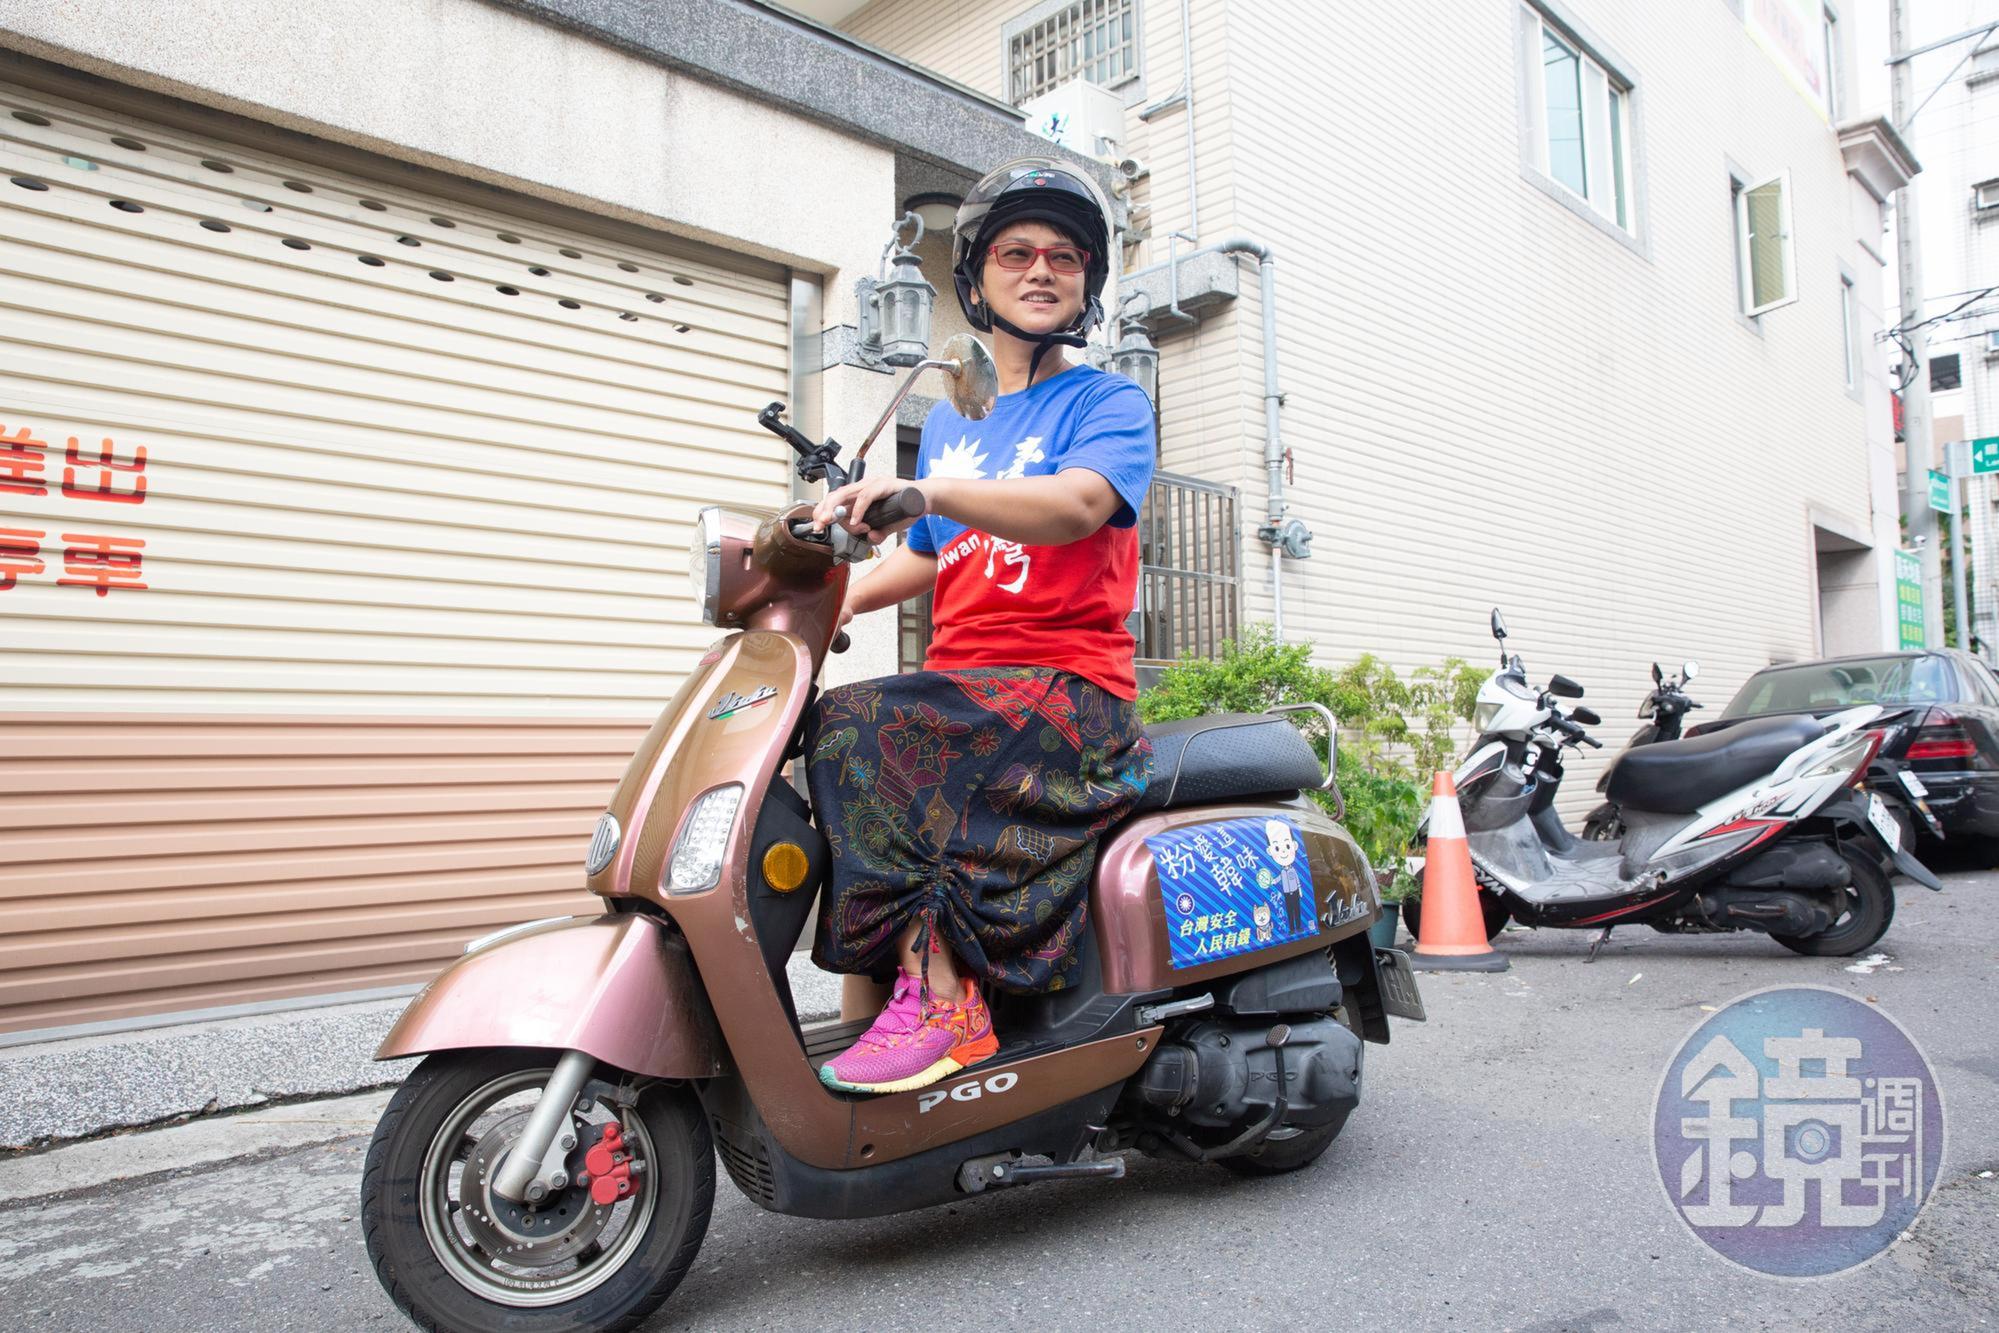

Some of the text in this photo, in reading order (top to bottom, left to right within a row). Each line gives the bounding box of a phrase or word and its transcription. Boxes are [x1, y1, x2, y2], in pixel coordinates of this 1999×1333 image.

[1180, 909, 1238, 938] 台灣安全
[1193, 927, 1252, 957] 人民有錢
[917, 1071, 1019, 1114] PGO
